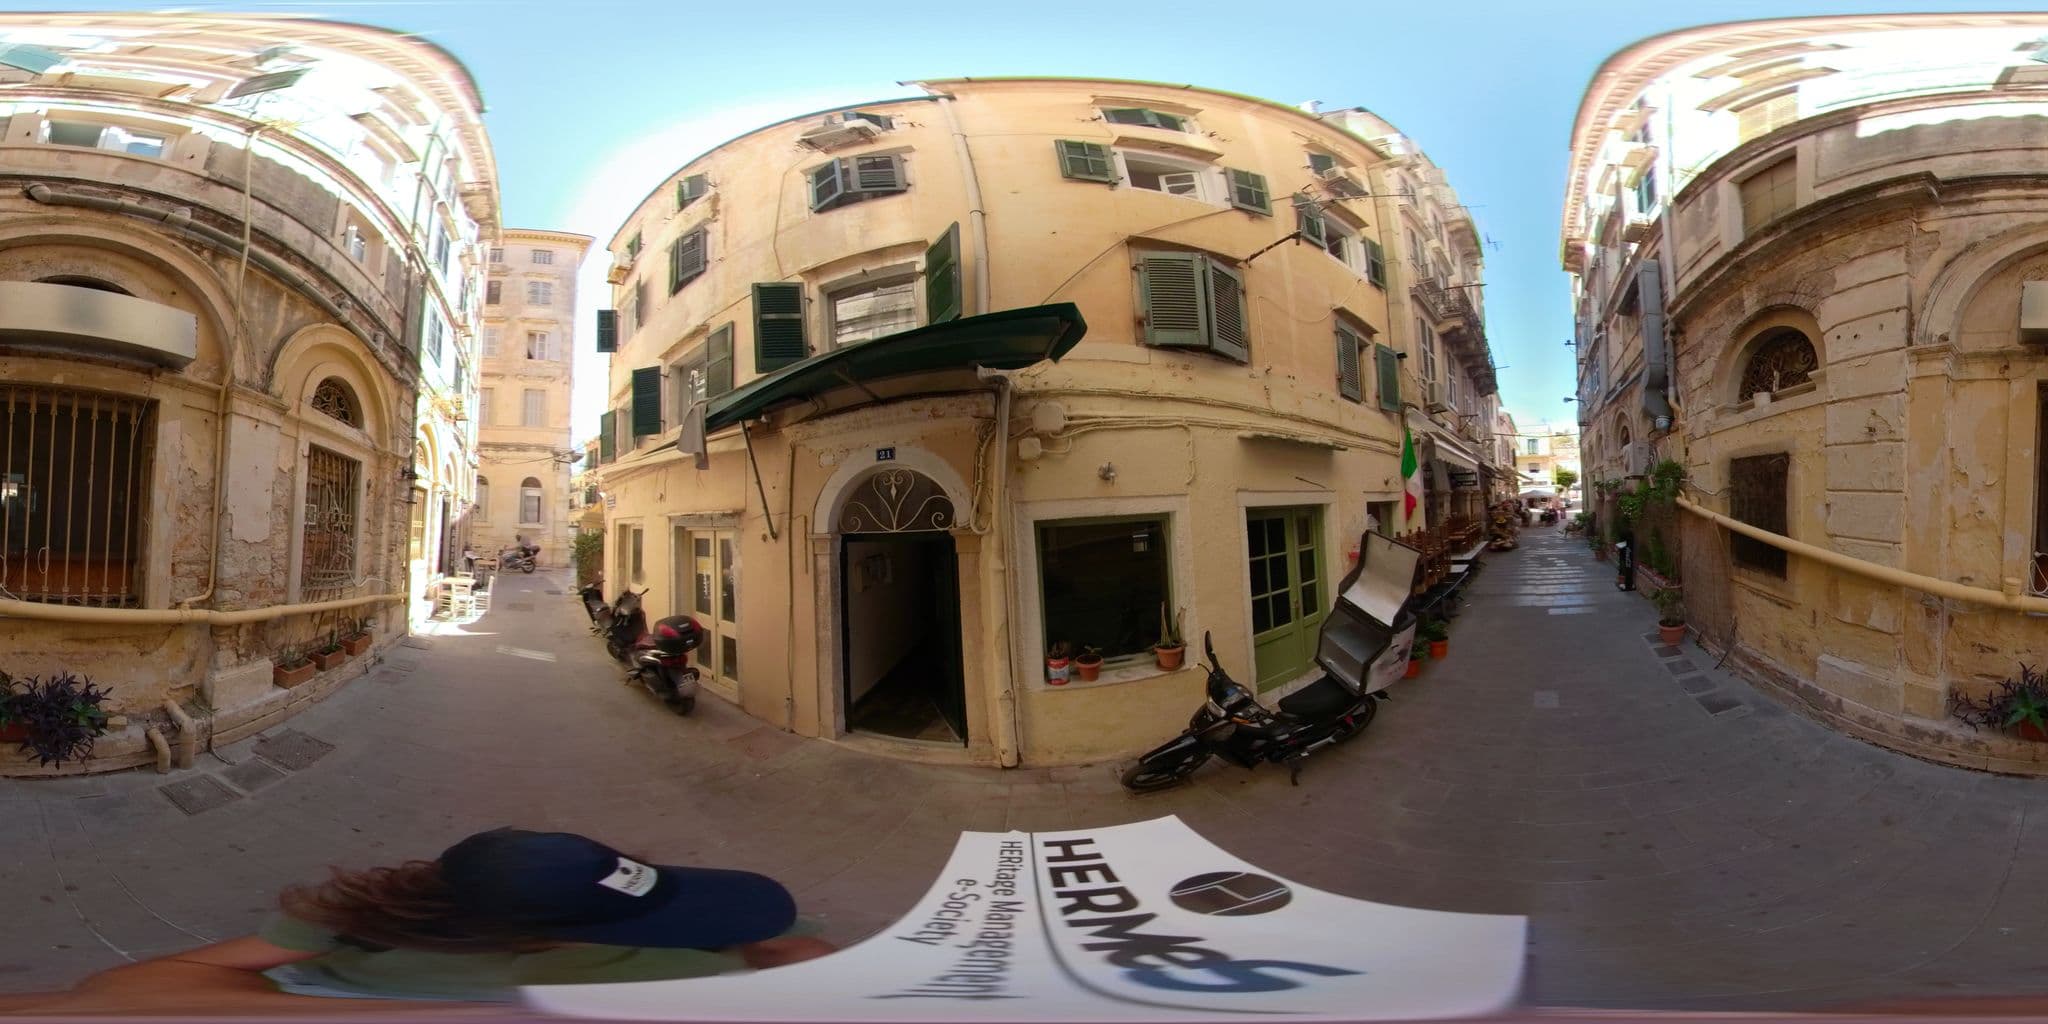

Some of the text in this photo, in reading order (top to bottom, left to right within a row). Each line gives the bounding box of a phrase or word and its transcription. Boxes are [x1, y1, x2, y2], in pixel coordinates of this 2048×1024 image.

[879, 450, 891, 460] 21
[866, 841, 1034, 1000] HERitage Management
[894, 878, 982, 946] e-Society
